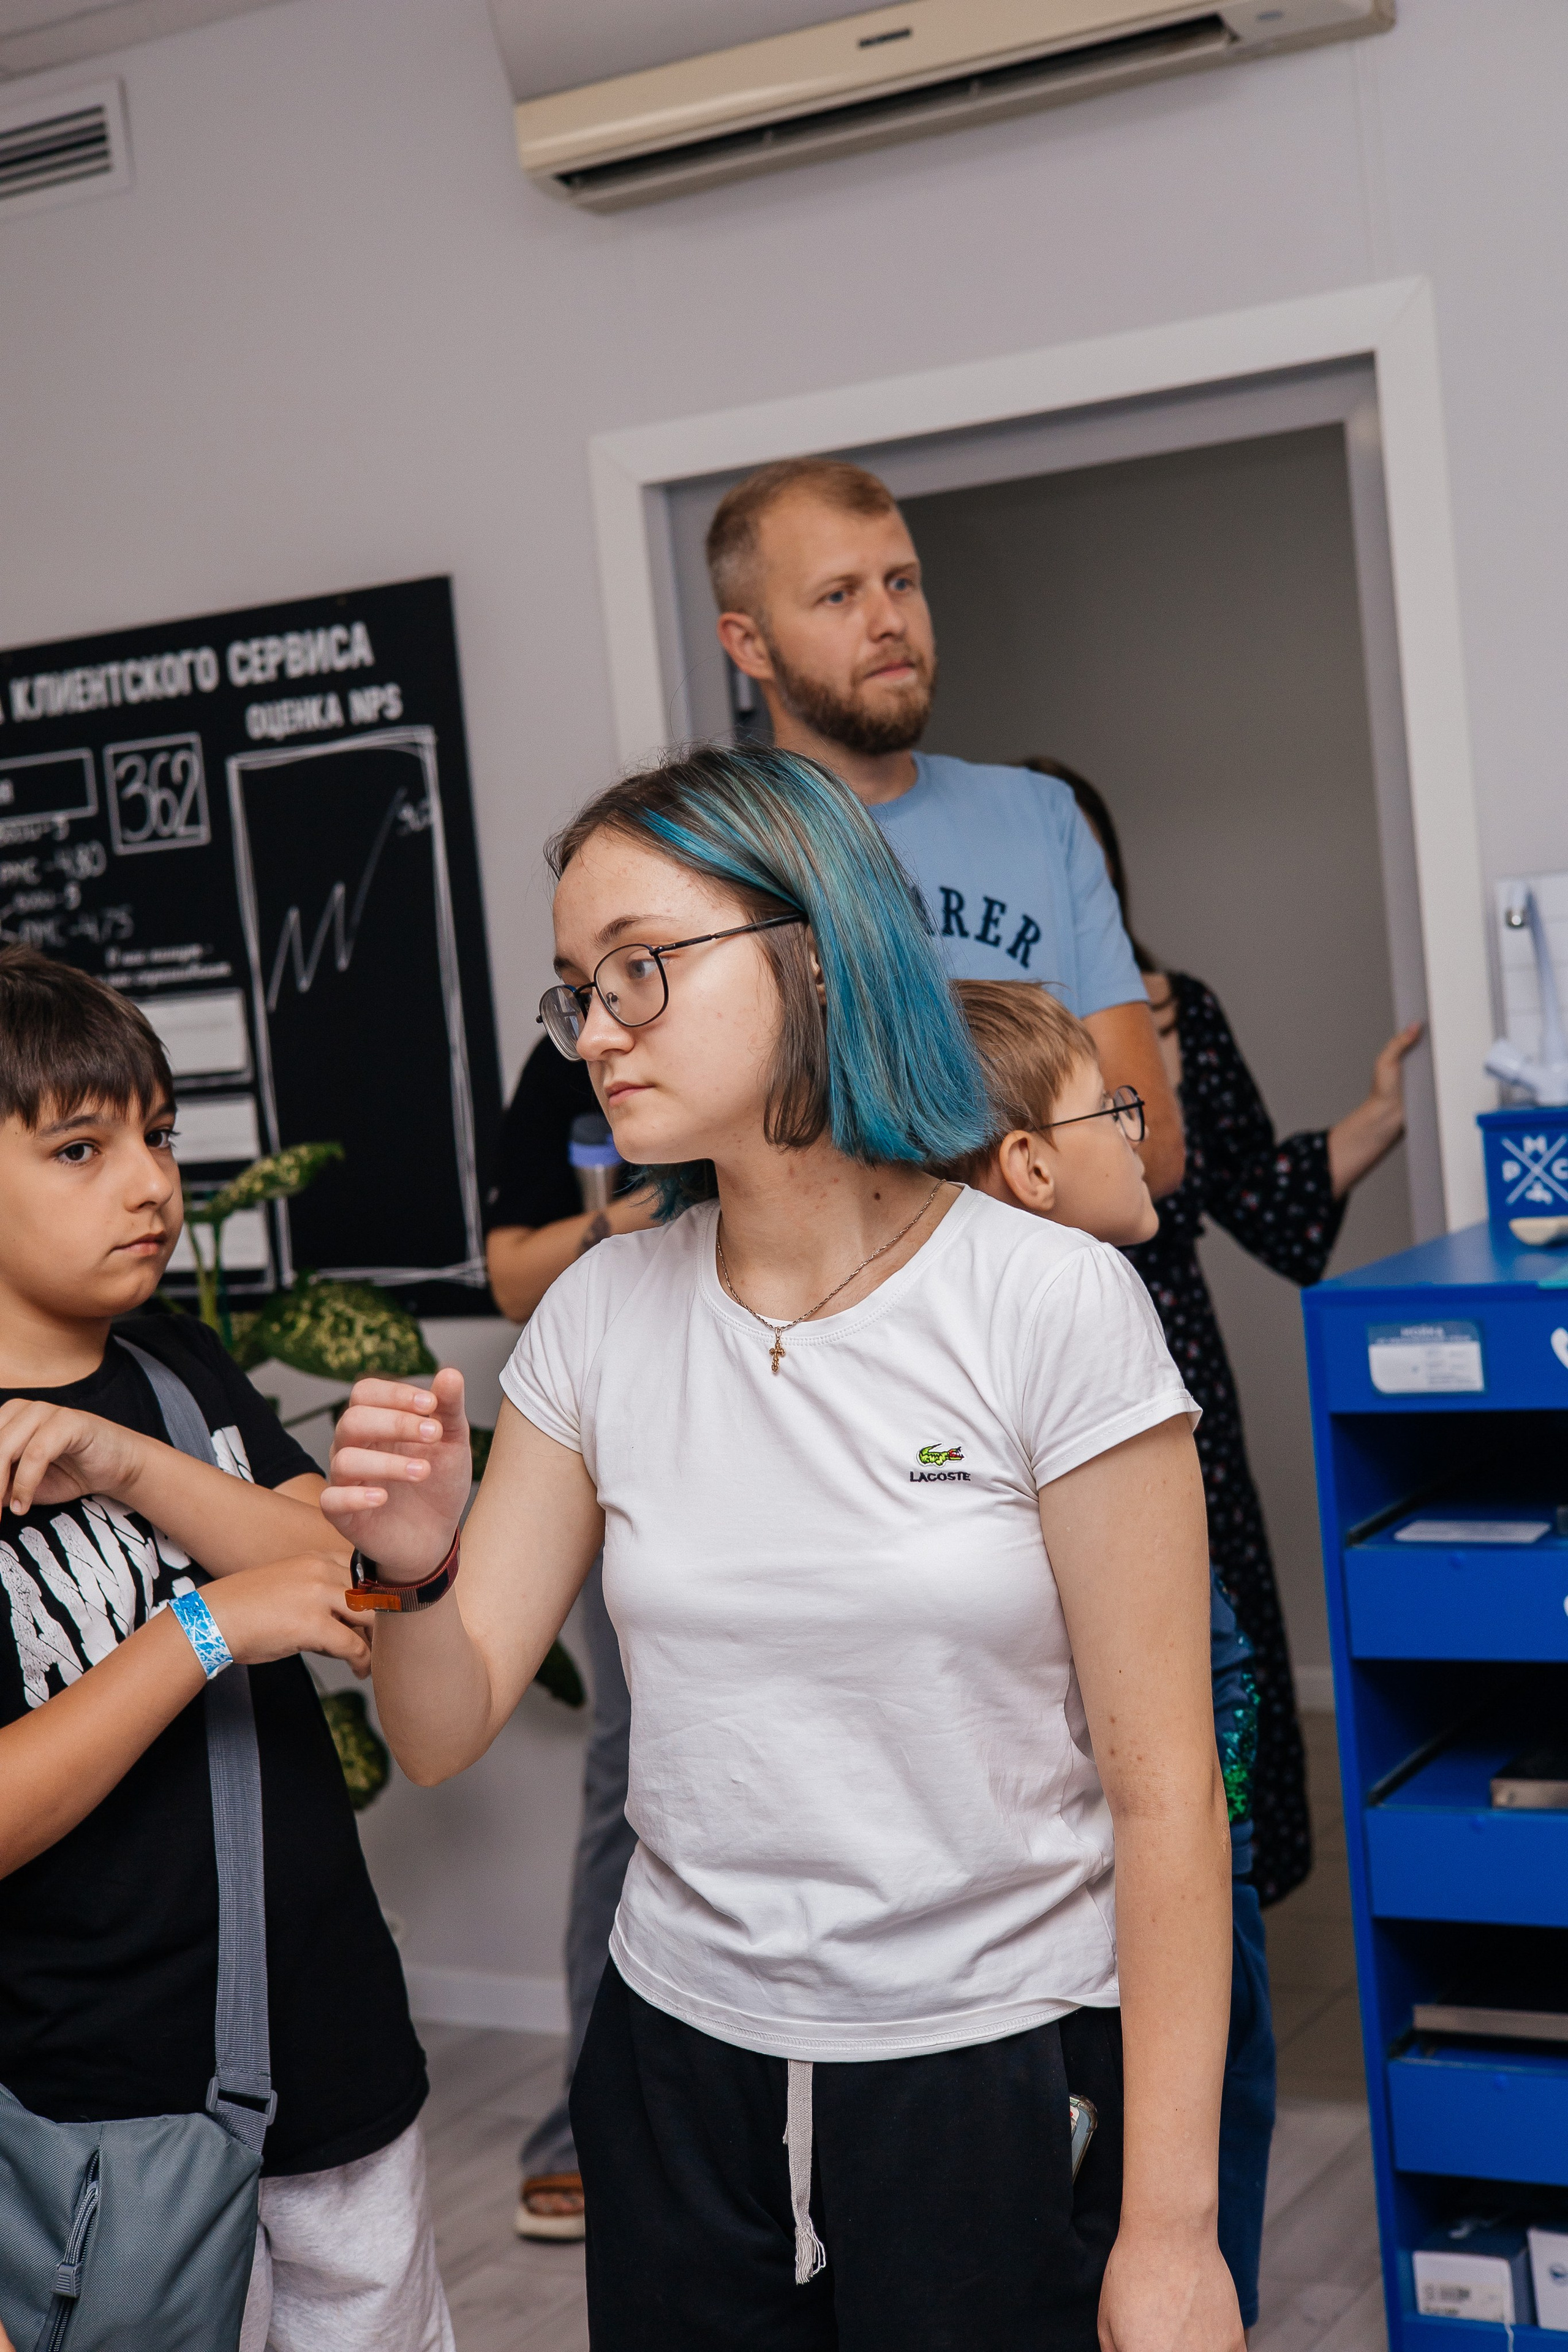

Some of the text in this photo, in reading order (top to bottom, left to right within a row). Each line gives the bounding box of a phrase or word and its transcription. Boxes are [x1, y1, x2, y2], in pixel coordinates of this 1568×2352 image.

[10, 621, 375, 723] КЛИЕНТСКОГО СЕРВИСА
[246, 682, 404, 741] ОЦЕНКА NPS
[115, 750, 200, 842] 362
[910, 1471, 971, 1482] LACOSTE
